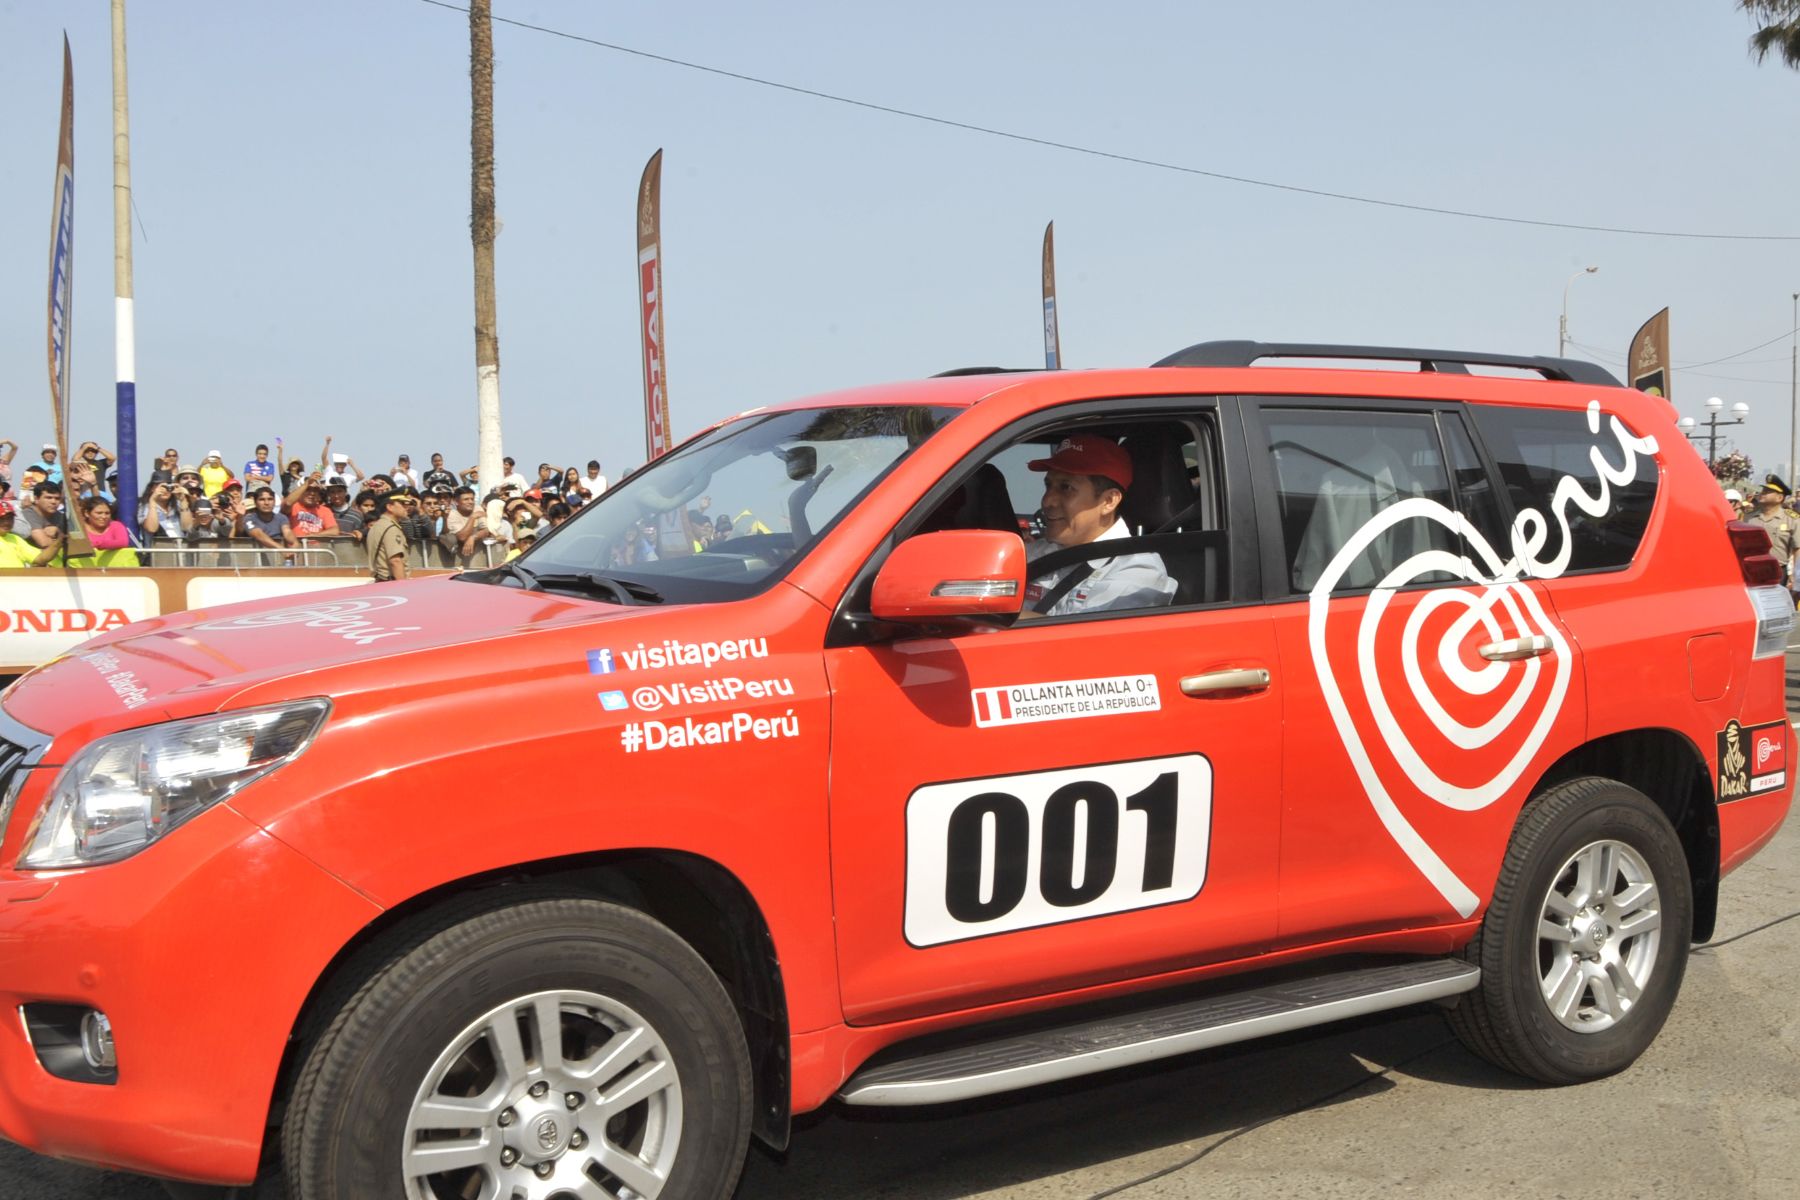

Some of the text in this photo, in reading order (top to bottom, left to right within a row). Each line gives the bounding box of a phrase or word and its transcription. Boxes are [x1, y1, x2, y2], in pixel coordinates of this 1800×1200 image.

[621, 637, 769, 672] visitaperu
[631, 677, 795, 712] @VisitPeru
[1012, 686, 1074, 703] OLLANTA
[1076, 680, 1132, 698] HUMALA
[1015, 702, 1077, 718] PRESIDENTE
[1078, 701, 1091, 712] DE
[1092, 700, 1105, 711] LA
[620, 709, 800, 753] #DakarPerú
[945, 771, 1179, 924] 001
